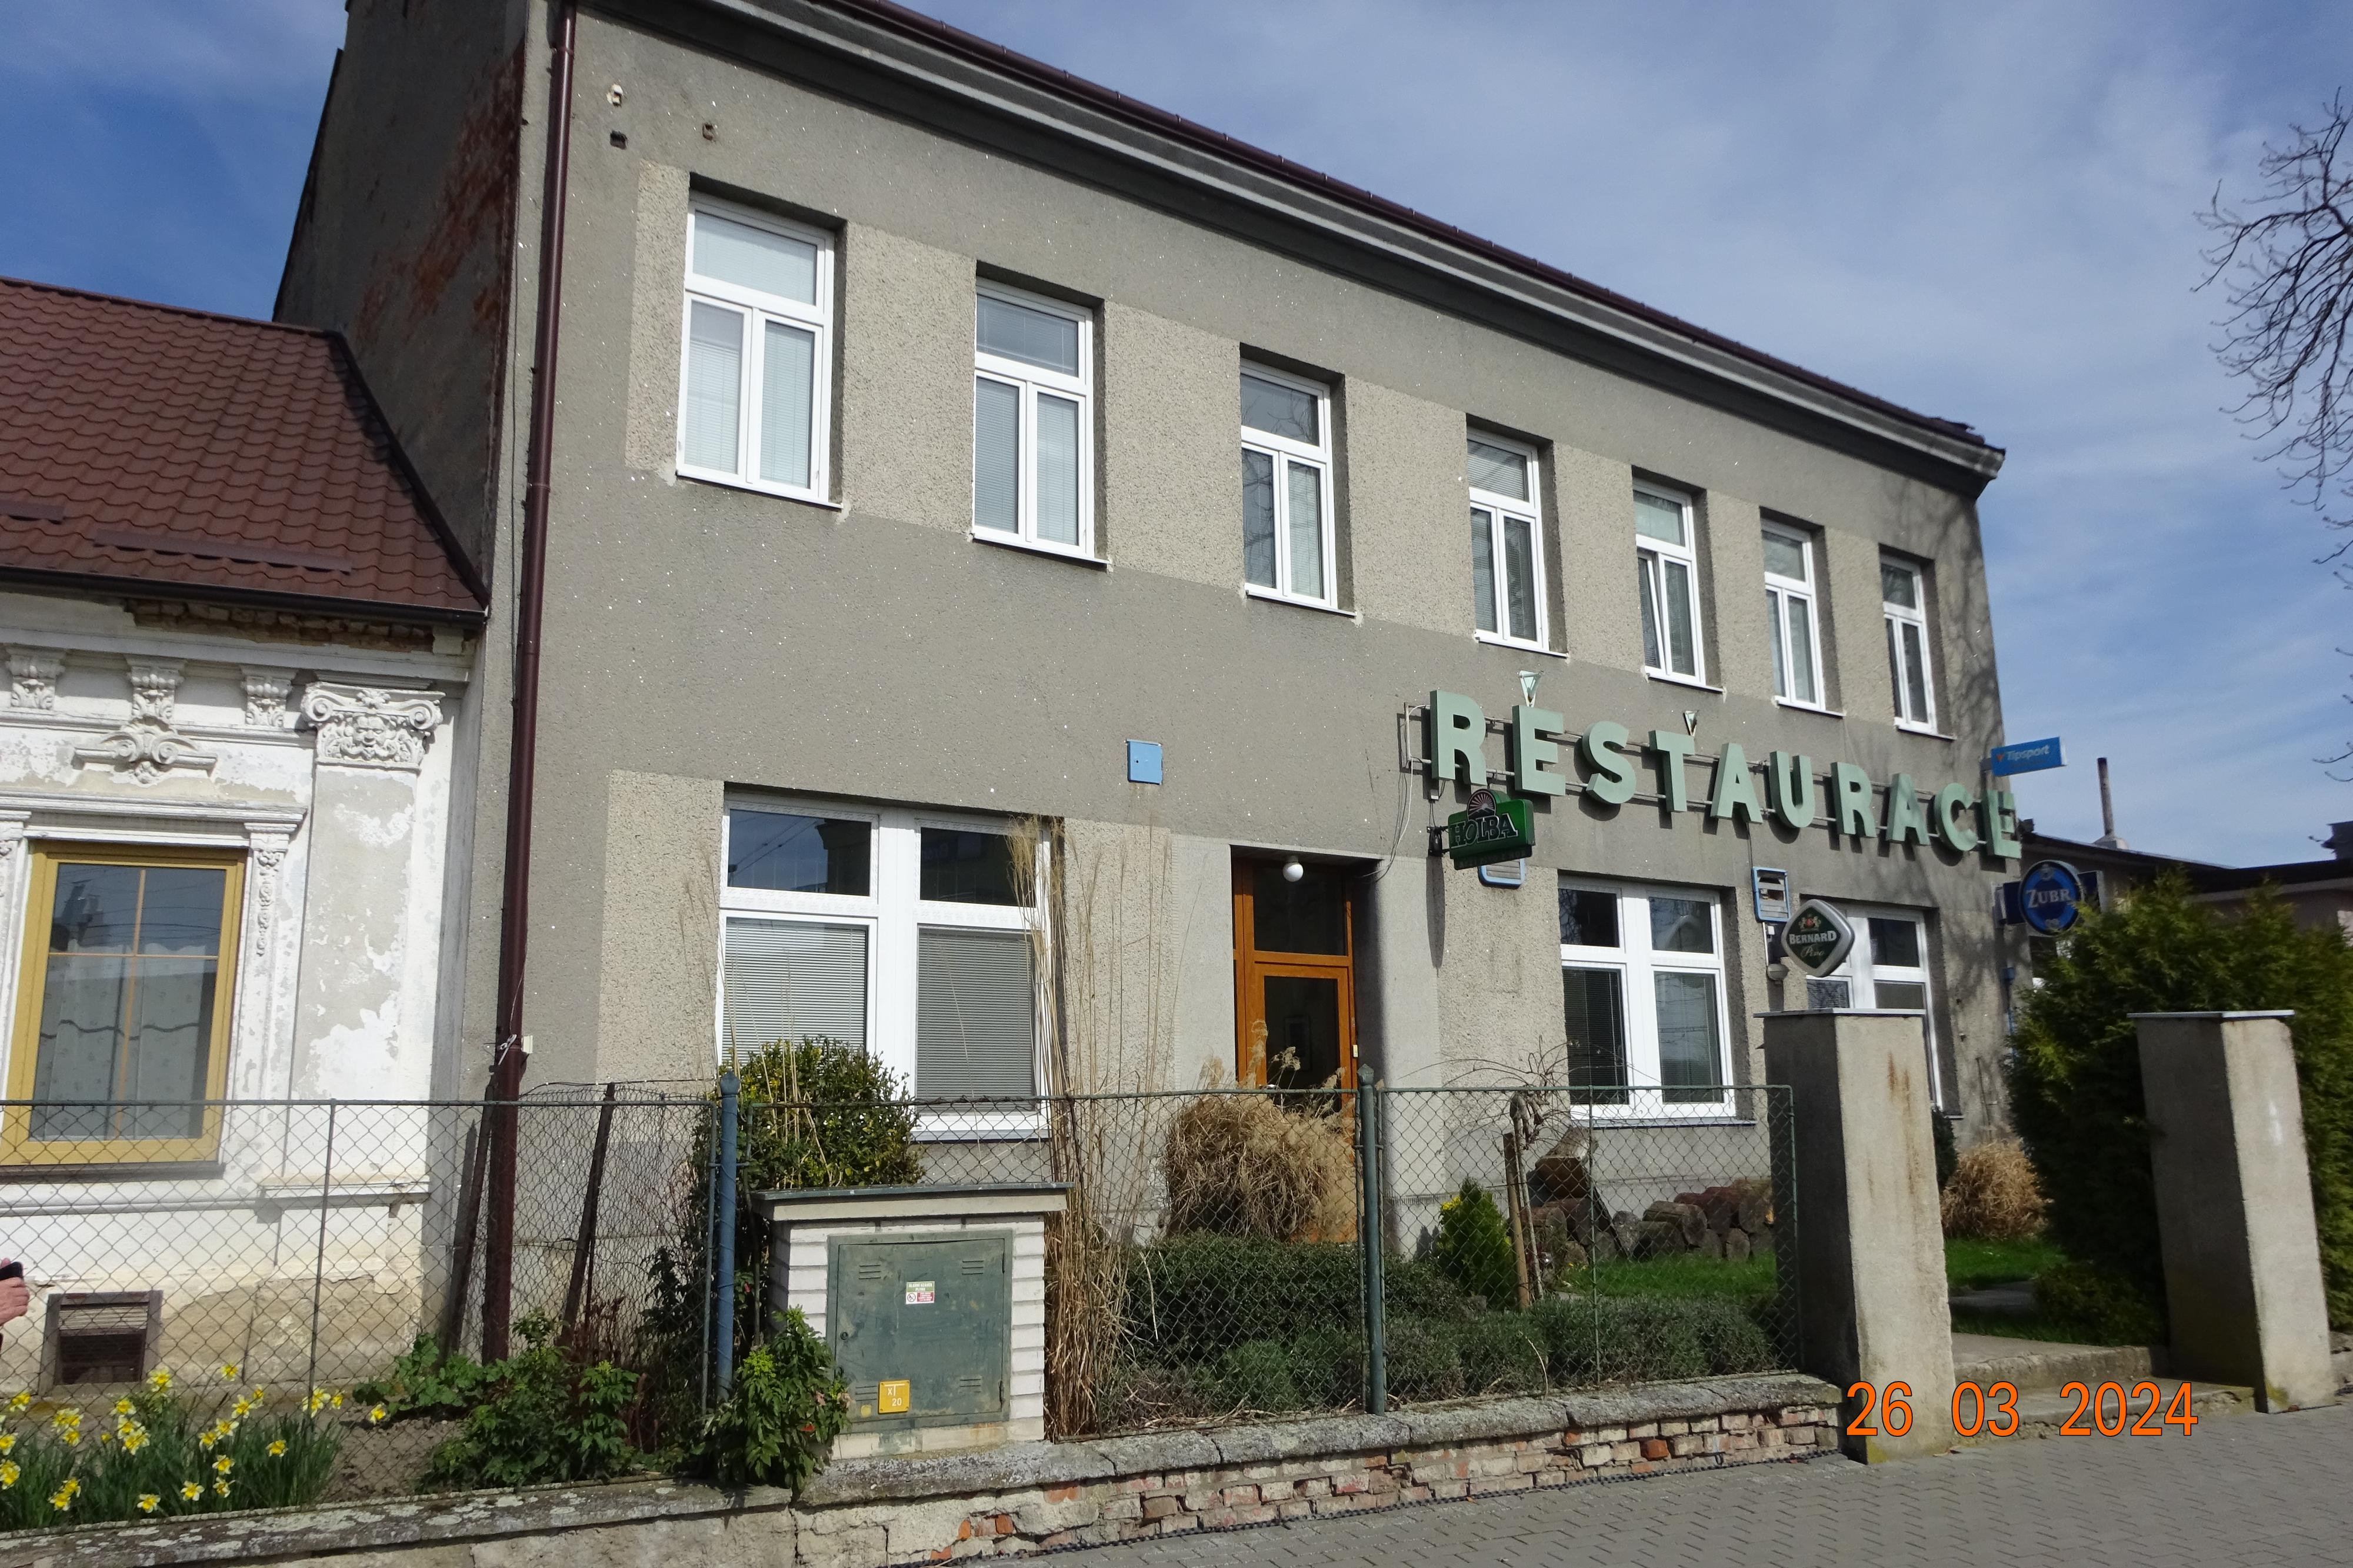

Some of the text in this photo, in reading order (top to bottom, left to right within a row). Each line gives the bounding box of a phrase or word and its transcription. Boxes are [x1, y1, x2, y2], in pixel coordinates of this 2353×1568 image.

[2007, 745, 2050, 761] Tipsport
[1429, 689, 2022, 859] RESTAURACE
[1449, 813, 1518, 848] HOLBA
[2026, 889, 2071, 908] ZUBR
[1789, 930, 1837, 945] BERNARD
[892, 1397, 902, 1406] 20
